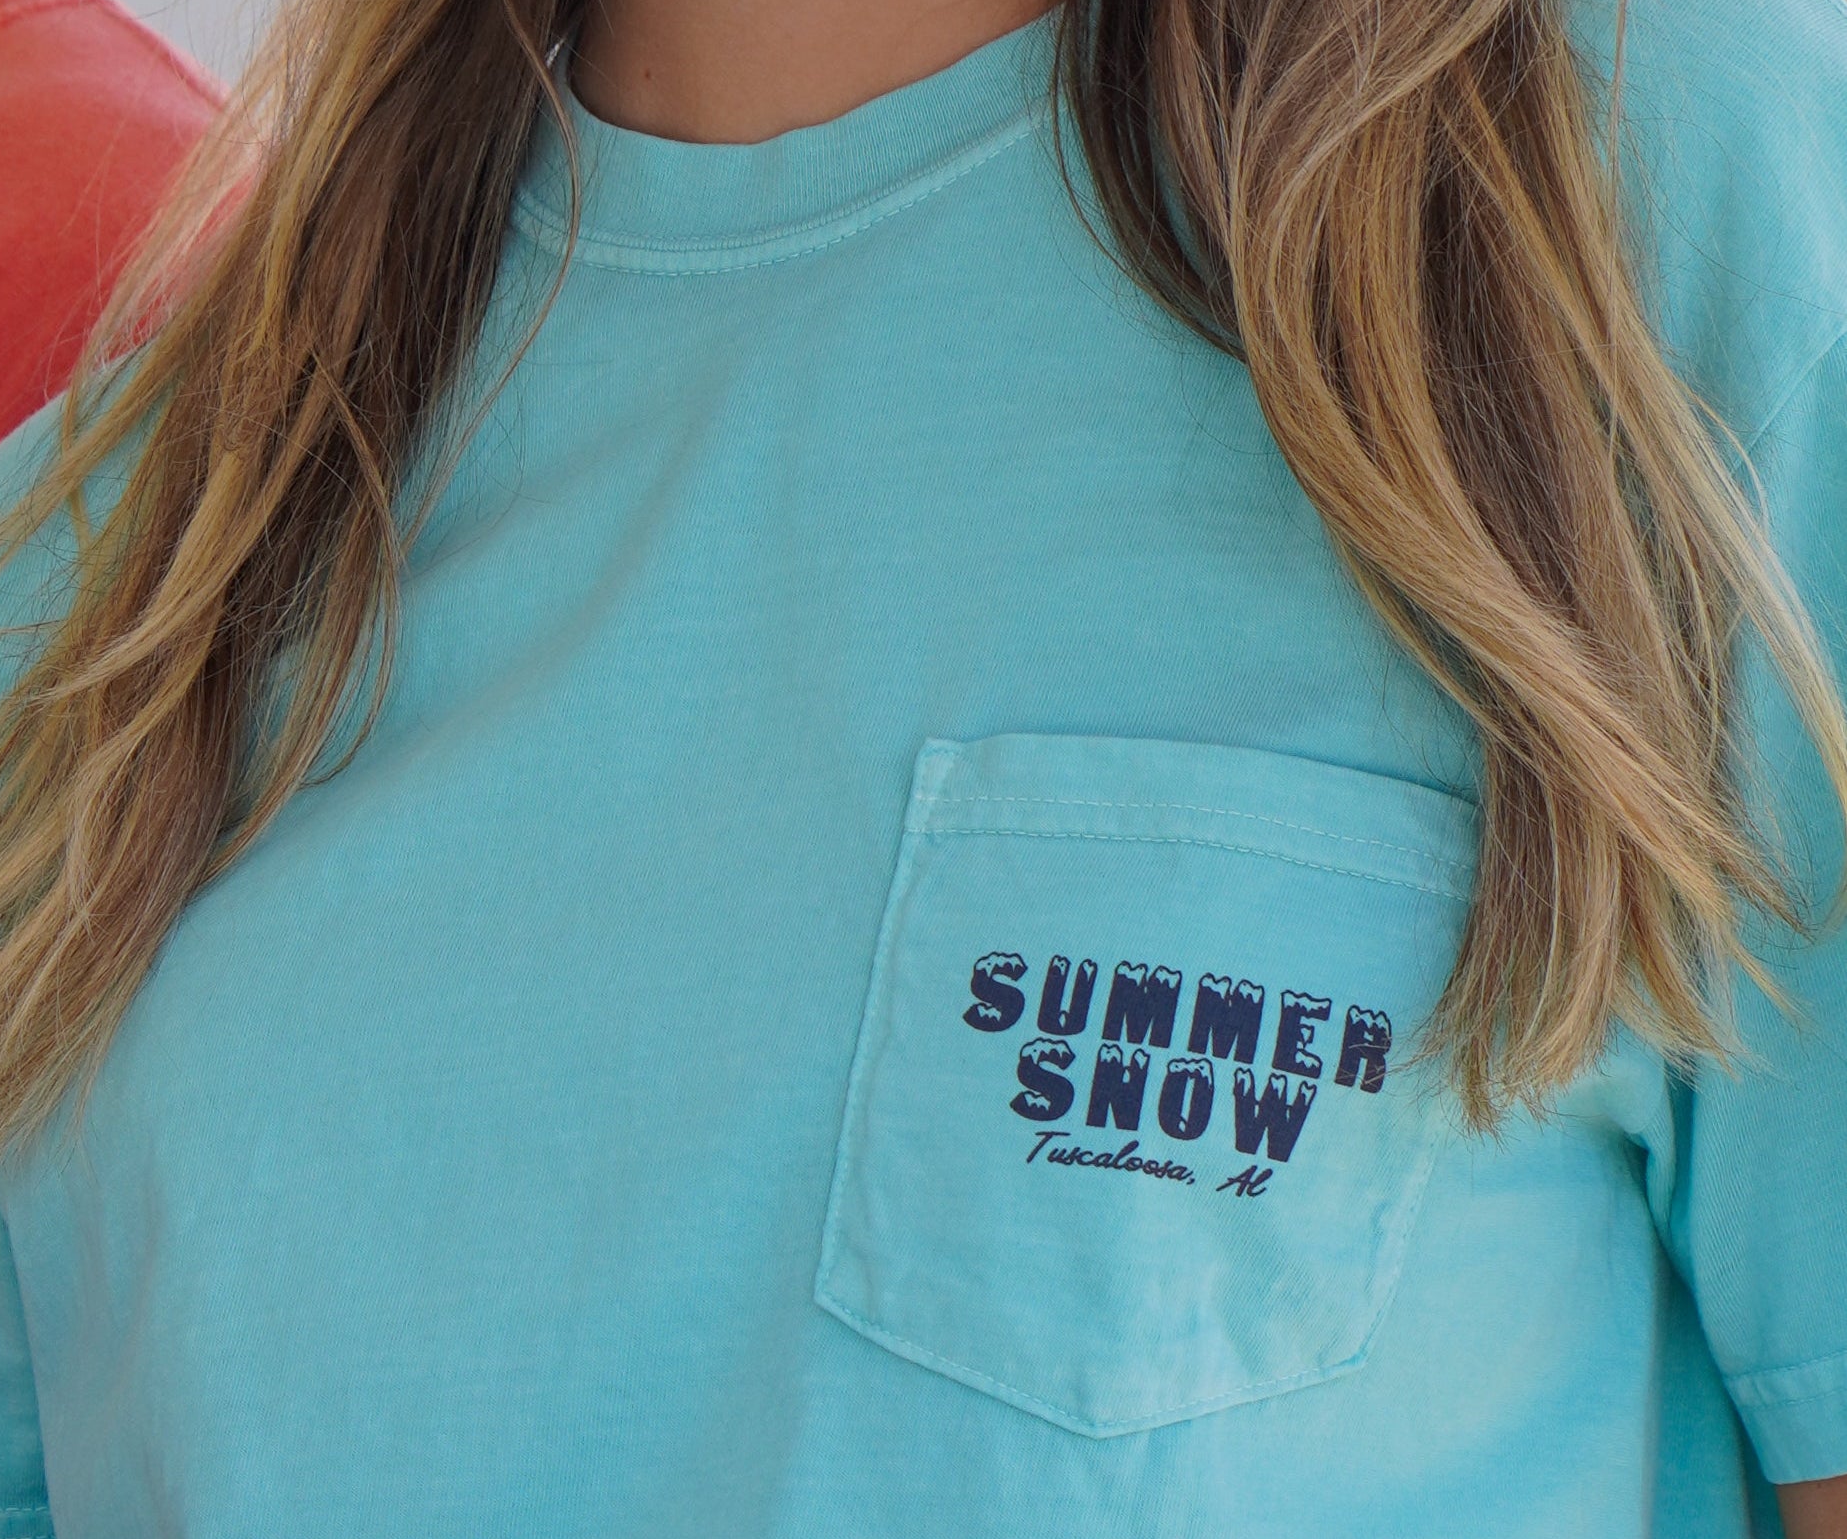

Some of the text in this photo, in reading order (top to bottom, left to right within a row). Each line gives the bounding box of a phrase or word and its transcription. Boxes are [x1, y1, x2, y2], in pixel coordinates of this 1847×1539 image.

[963, 951, 1393, 1094] SUMMER
[1010, 1037, 1317, 1163] SNOW
[1025, 1131, 1196, 1186] Tuscaloosa,
